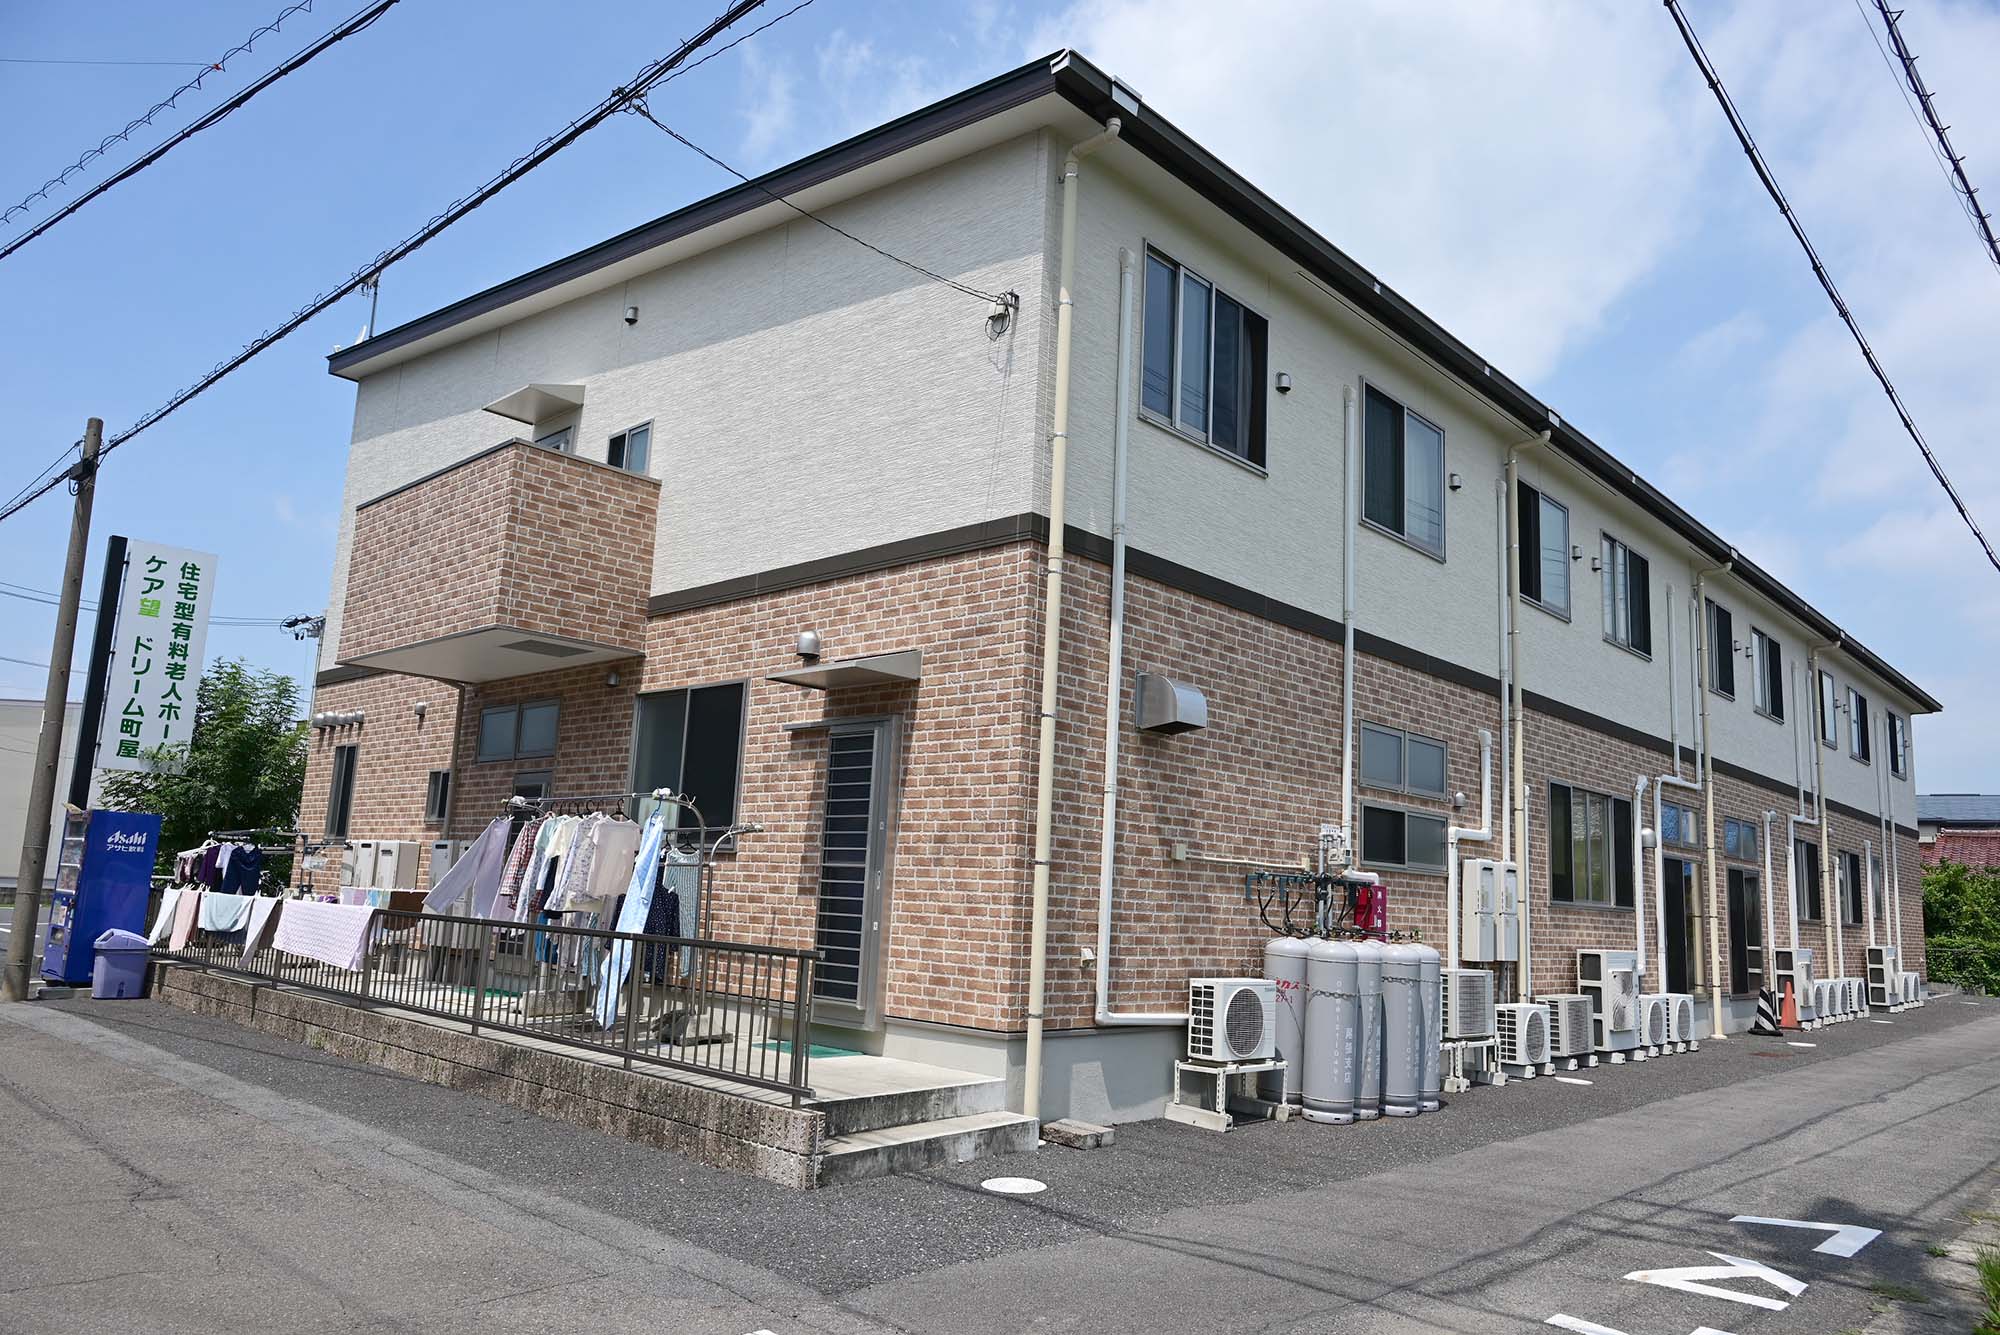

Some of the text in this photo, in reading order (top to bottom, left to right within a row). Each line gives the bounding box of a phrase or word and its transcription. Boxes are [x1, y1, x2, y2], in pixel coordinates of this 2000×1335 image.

[115, 554, 168, 759] ケア望 ドリーム町屋
[154, 561, 201, 757] 住宅型有料老人ホー
[107, 829, 147, 845] Asahi
